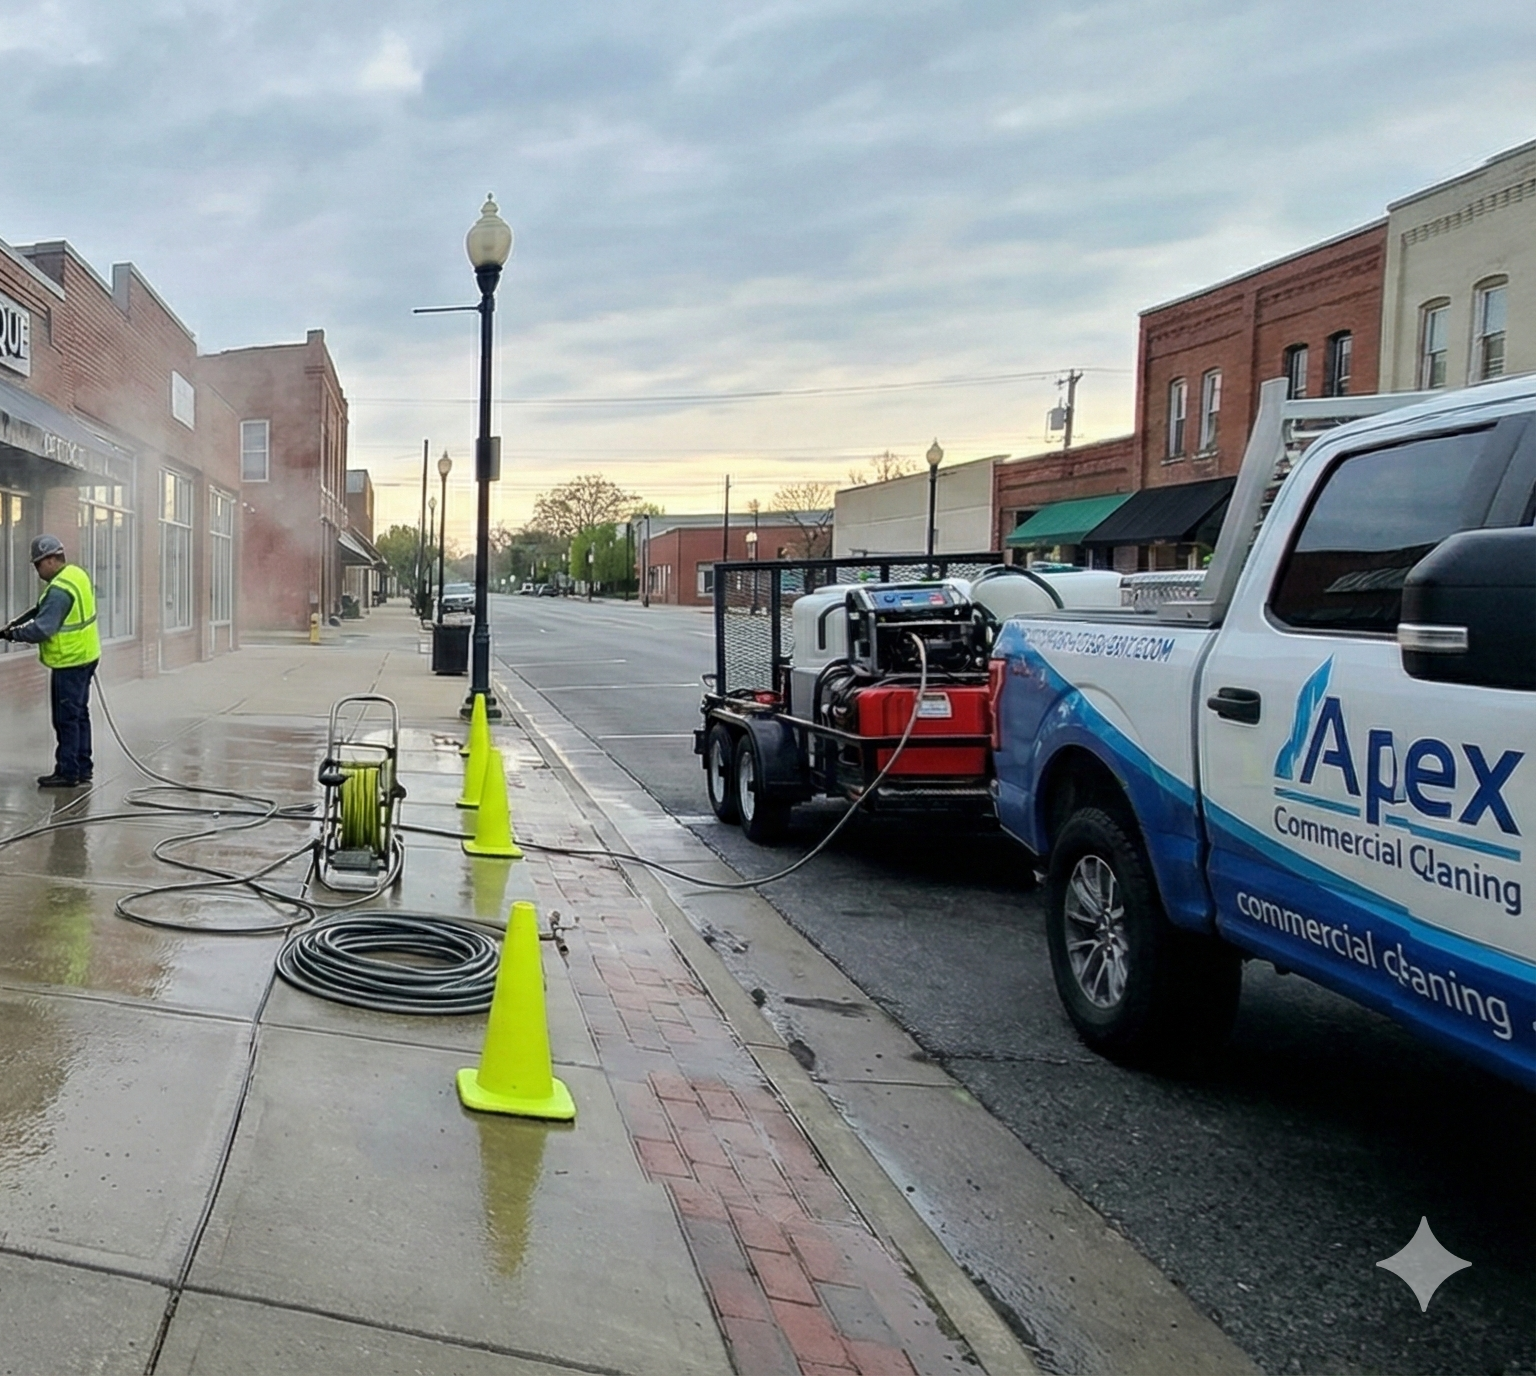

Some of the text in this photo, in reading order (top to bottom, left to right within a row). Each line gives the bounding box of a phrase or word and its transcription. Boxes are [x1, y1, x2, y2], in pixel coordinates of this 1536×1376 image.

[1299, 696, 1525, 837] Apex
[1274, 805, 1402, 869] Commercial
[1237, 891, 1378, 969] commercial
